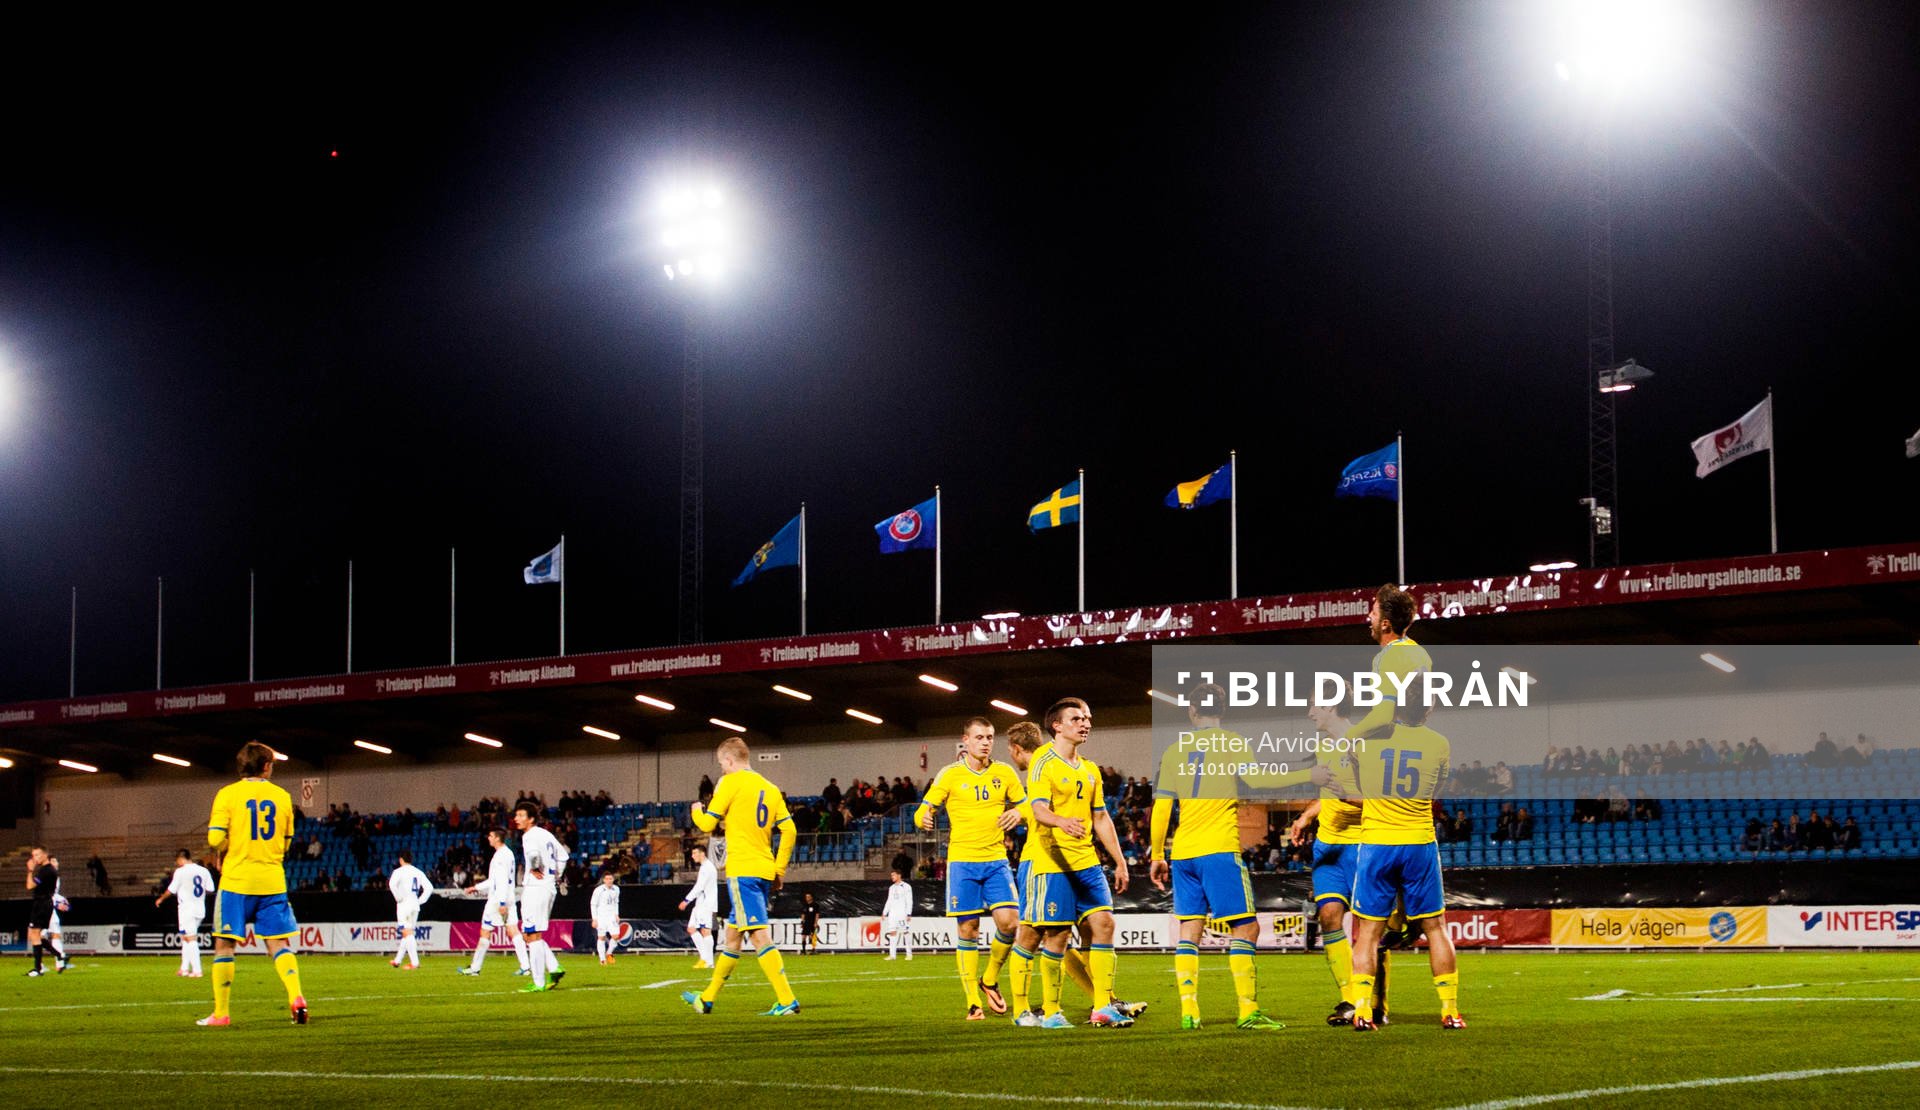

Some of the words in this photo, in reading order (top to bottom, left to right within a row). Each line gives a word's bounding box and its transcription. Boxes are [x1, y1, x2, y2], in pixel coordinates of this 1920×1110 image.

[1619, 564, 1801, 593] www.trelleborgsallehanda.se
[1441, 590, 1503, 609] Trelleborgs
[1258, 605, 1317, 624] Trelleborgs
[1318, 600, 1369, 618] Allehanda
[772, 645, 818, 662] Trelleborgs
[819, 641, 860, 658] Allehanda
[915, 633, 965, 651] Trelleborgs
[500, 669, 540, 685] Trelleborgs
[540, 664, 576, 680] Allehanda
[610, 654, 722, 677] www.trelleborgsallehanda.se
[385, 678, 423, 692] Trelleborgs
[424, 675, 457, 690] Allehanda
[1187, 750, 1206, 799] 7
[1379, 747, 1423, 799] 15
[974, 784, 989, 801] 16
[1076, 780, 1083, 800] 2
[245, 798, 276, 841] 13
[756, 789, 769, 829] 6
[193, 875, 203, 898] 8
[411, 877, 420, 898] 4
[299, 926, 324, 947] ICA
[362, 925, 433, 941] INTERSORT
[633, 926, 661, 942] pepsi
[1120, 930, 1160, 946] SPEL
[1446, 914, 1499, 941] ndic
[1580, 918, 1622, 937] Hela
[1629, 917, 1686, 941] vägen
